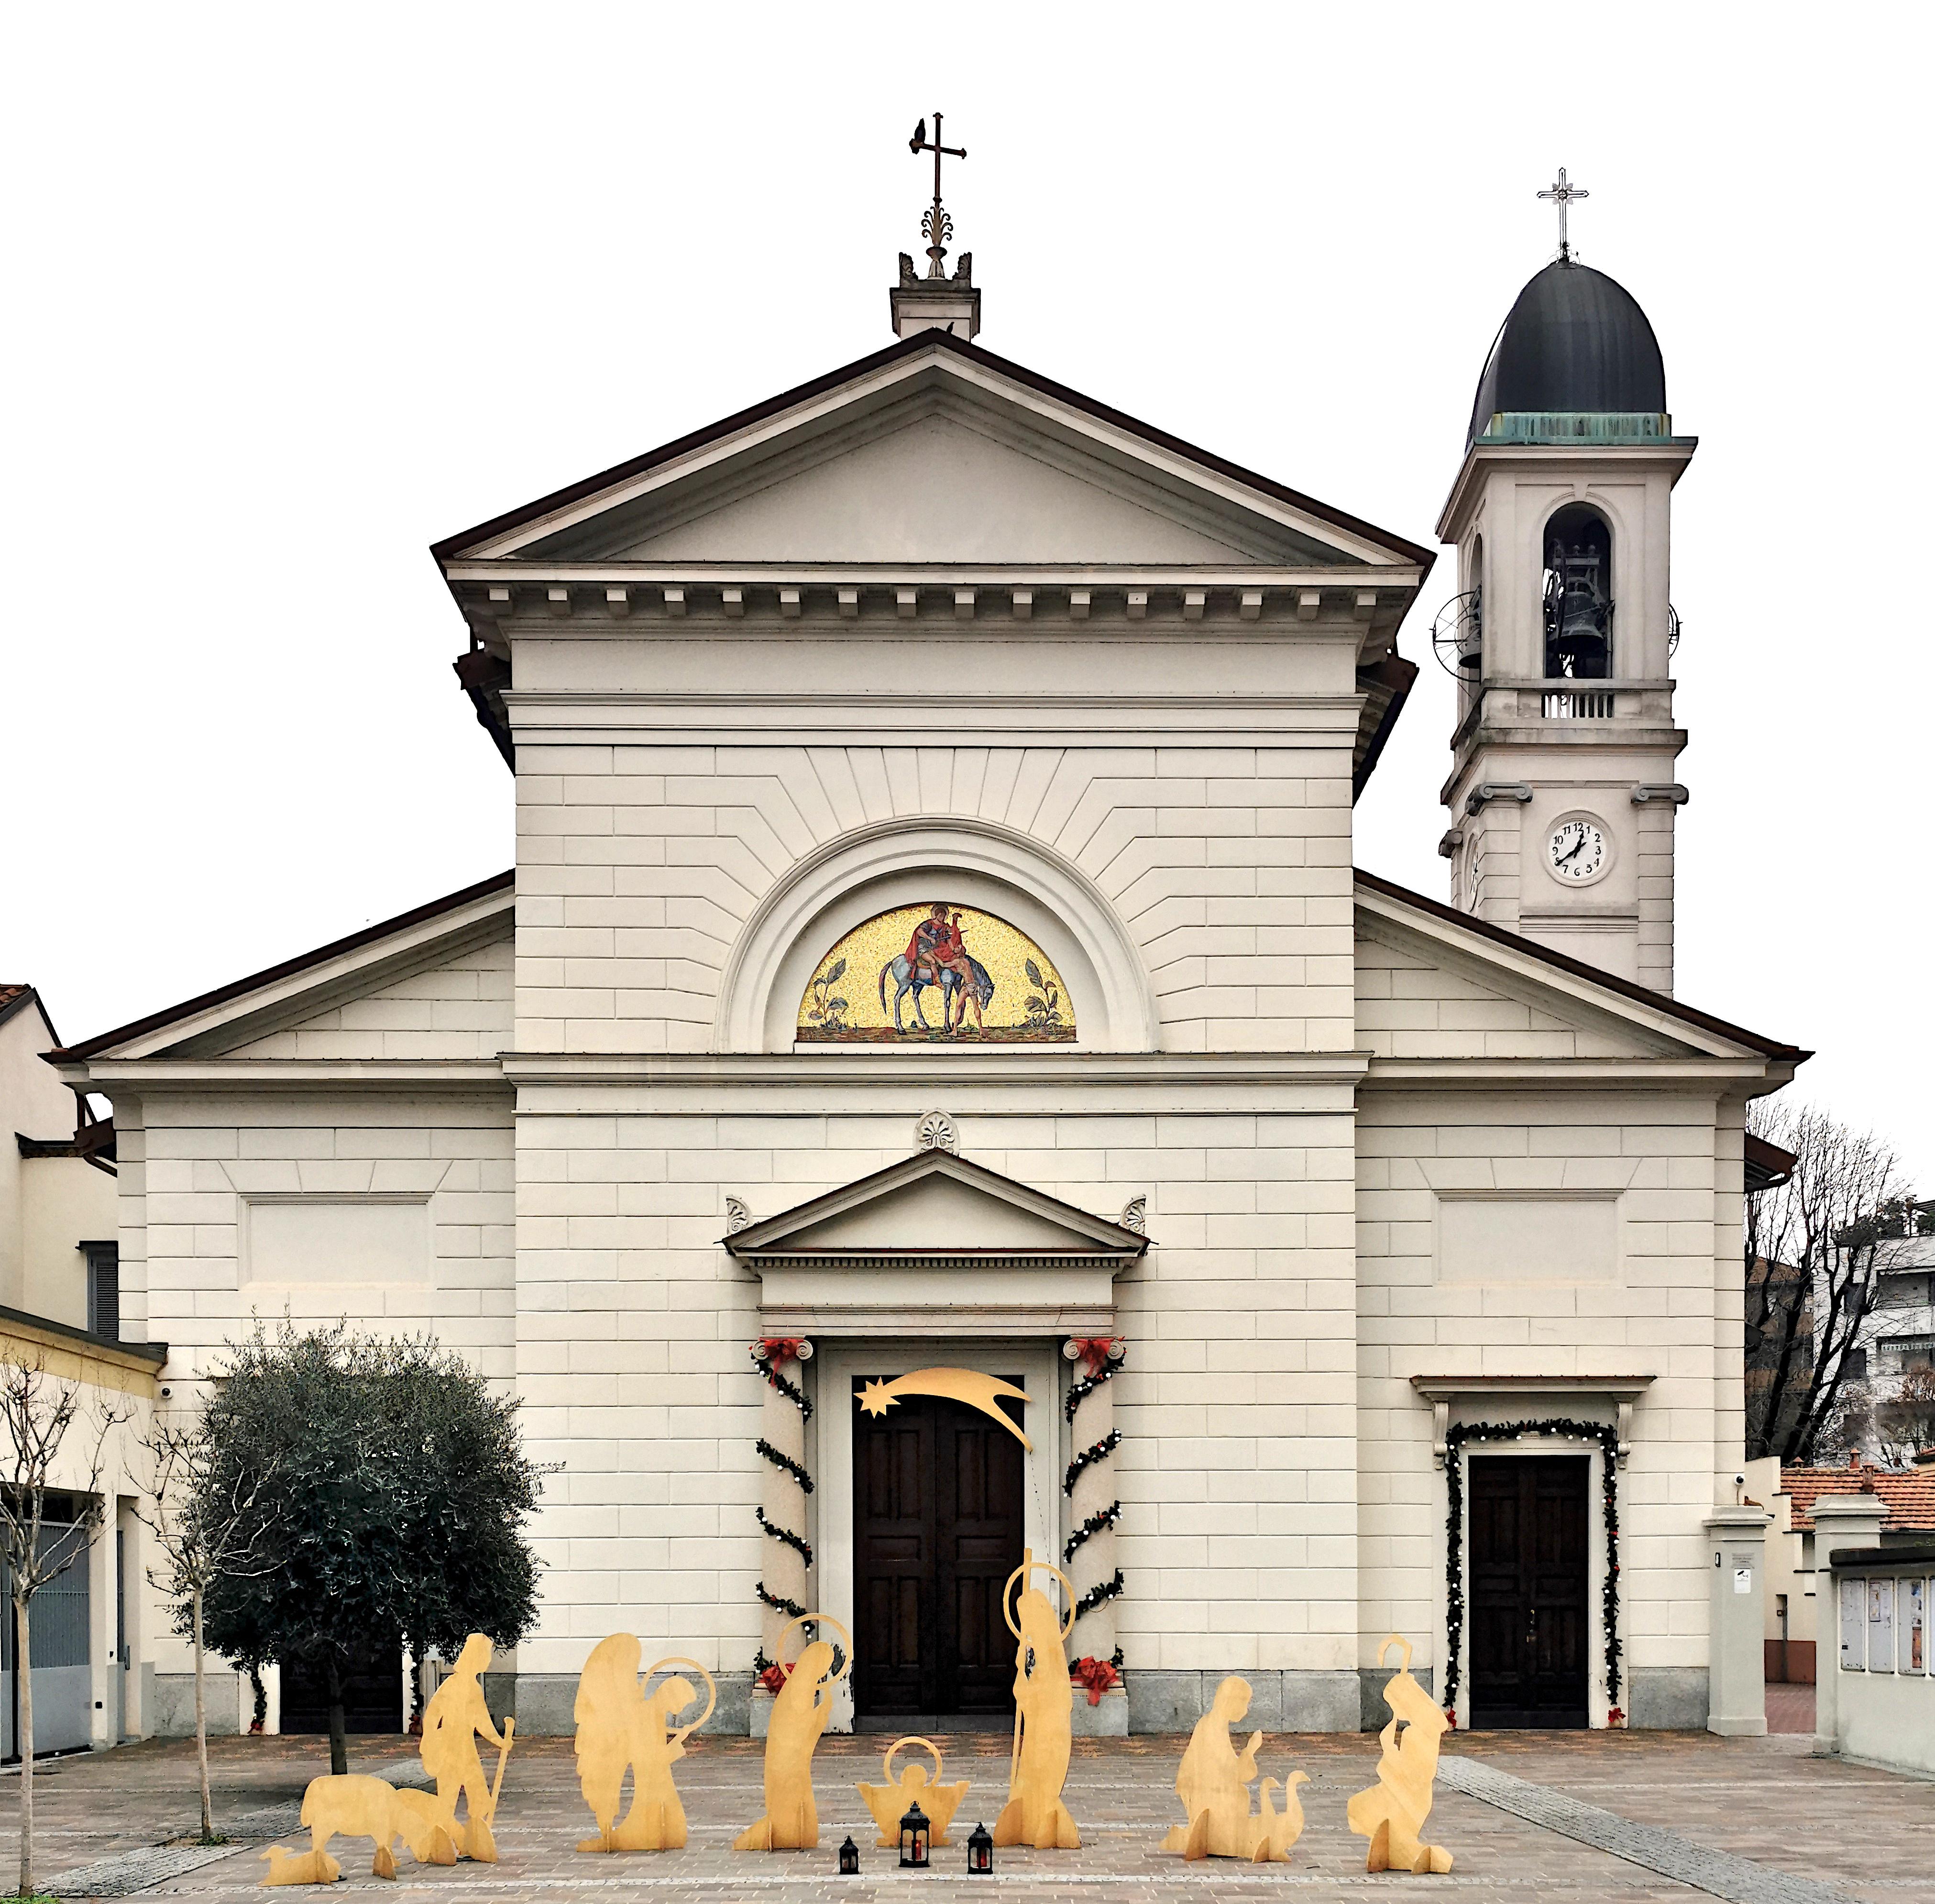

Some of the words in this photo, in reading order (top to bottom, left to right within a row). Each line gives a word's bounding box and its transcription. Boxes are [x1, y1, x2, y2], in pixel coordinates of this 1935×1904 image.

[1562, 825, 1571, 835] 11
[1573, 822, 1583, 832] 12
[1586, 825, 1590, 834] 1
[1553, 836, 1563, 844] 10
[1594, 833, 1600, 842] 2
[1552, 847, 1558, 856] 9
[1595, 846, 1601, 855] 3
[1554, 857, 1560, 866] 8
[1594, 858, 1599, 867] 4
[1562, 864, 1569, 873] 7
[1574, 868, 1580, 876] 6
[1586, 864, 1592, 873] 5
